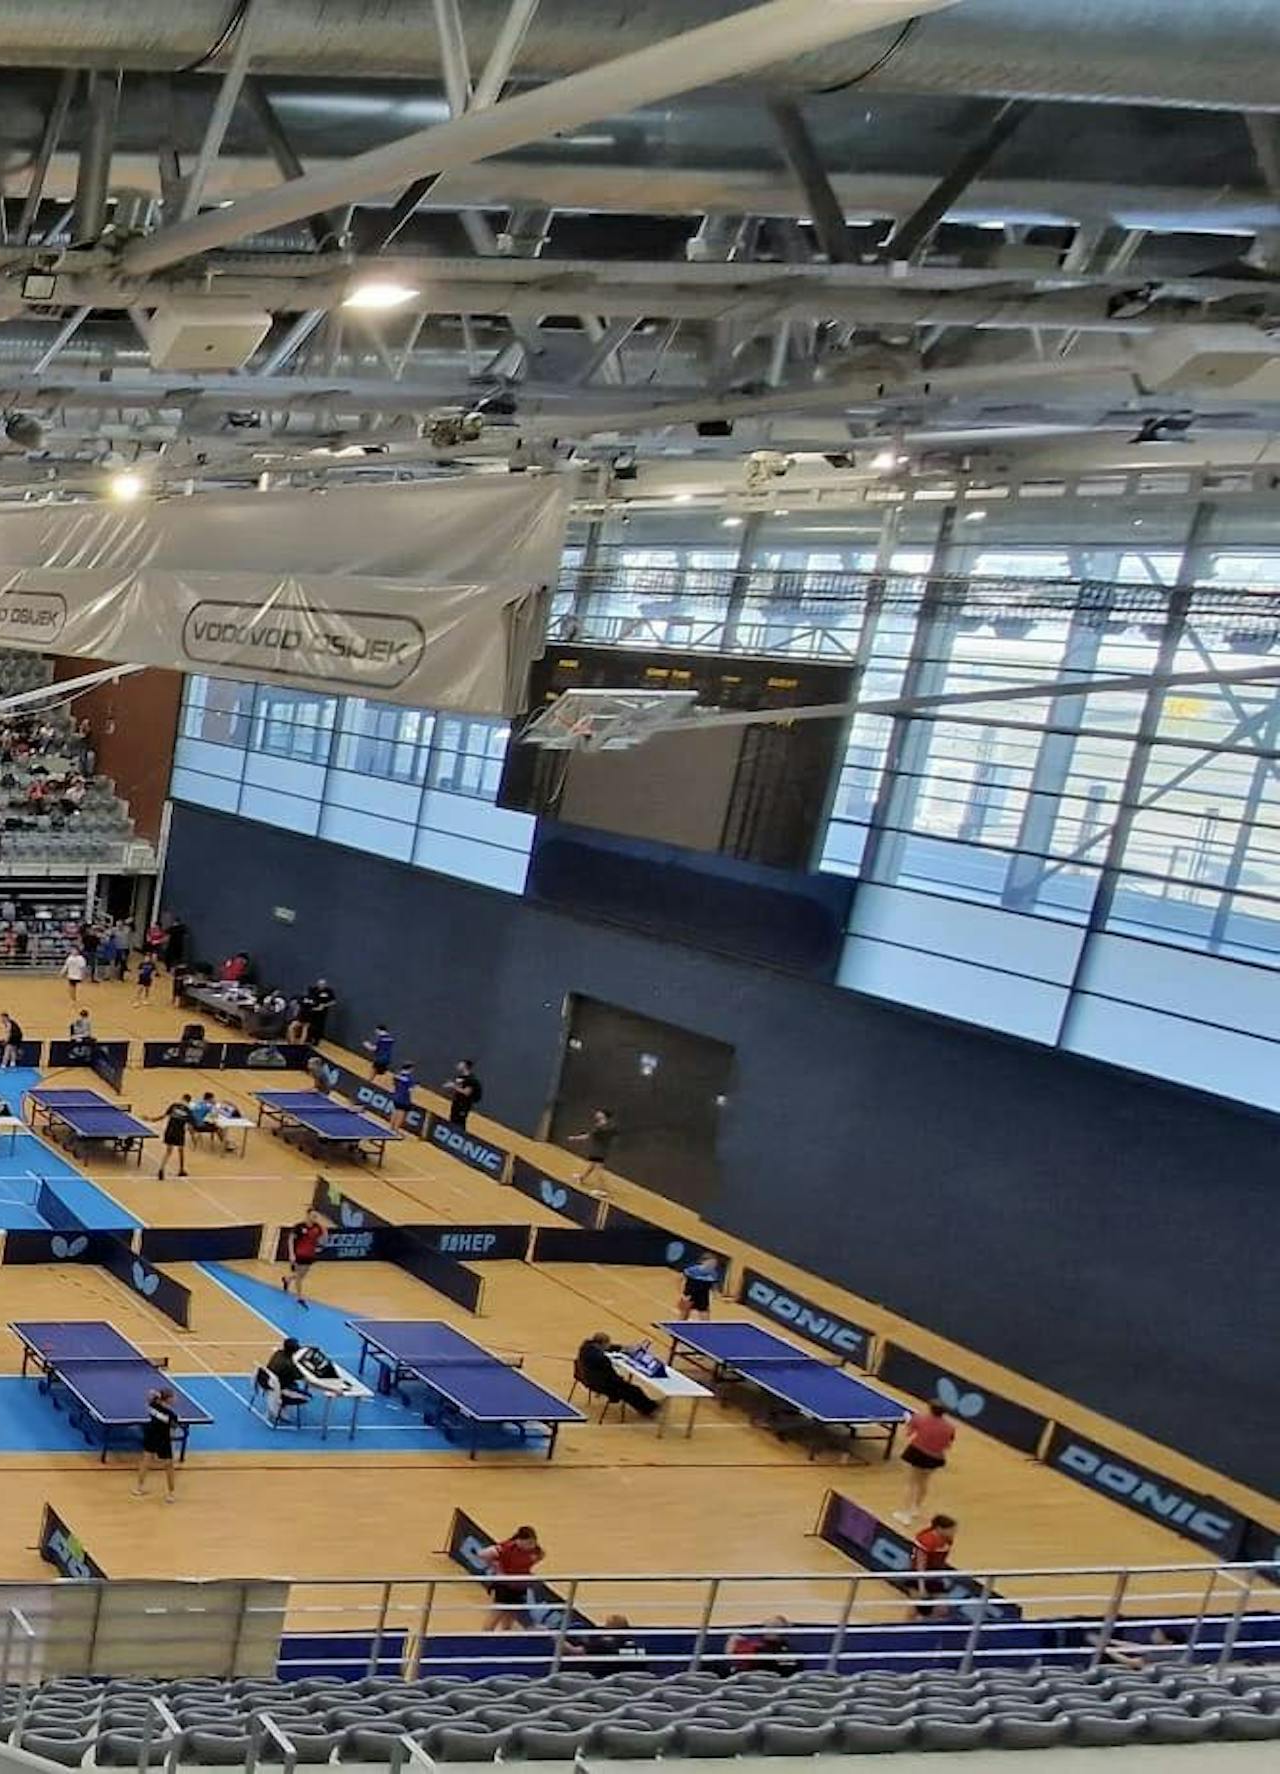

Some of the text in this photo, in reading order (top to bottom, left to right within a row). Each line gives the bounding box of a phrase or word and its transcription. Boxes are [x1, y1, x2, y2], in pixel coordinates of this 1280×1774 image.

[357, 1086, 422, 1127] DOC
[433, 1124, 501, 1170] DONIC
[459, 1233, 497, 1252] HEP
[747, 1281, 863, 1351] DONIC
[1058, 1445, 1233, 1540] DONIC
